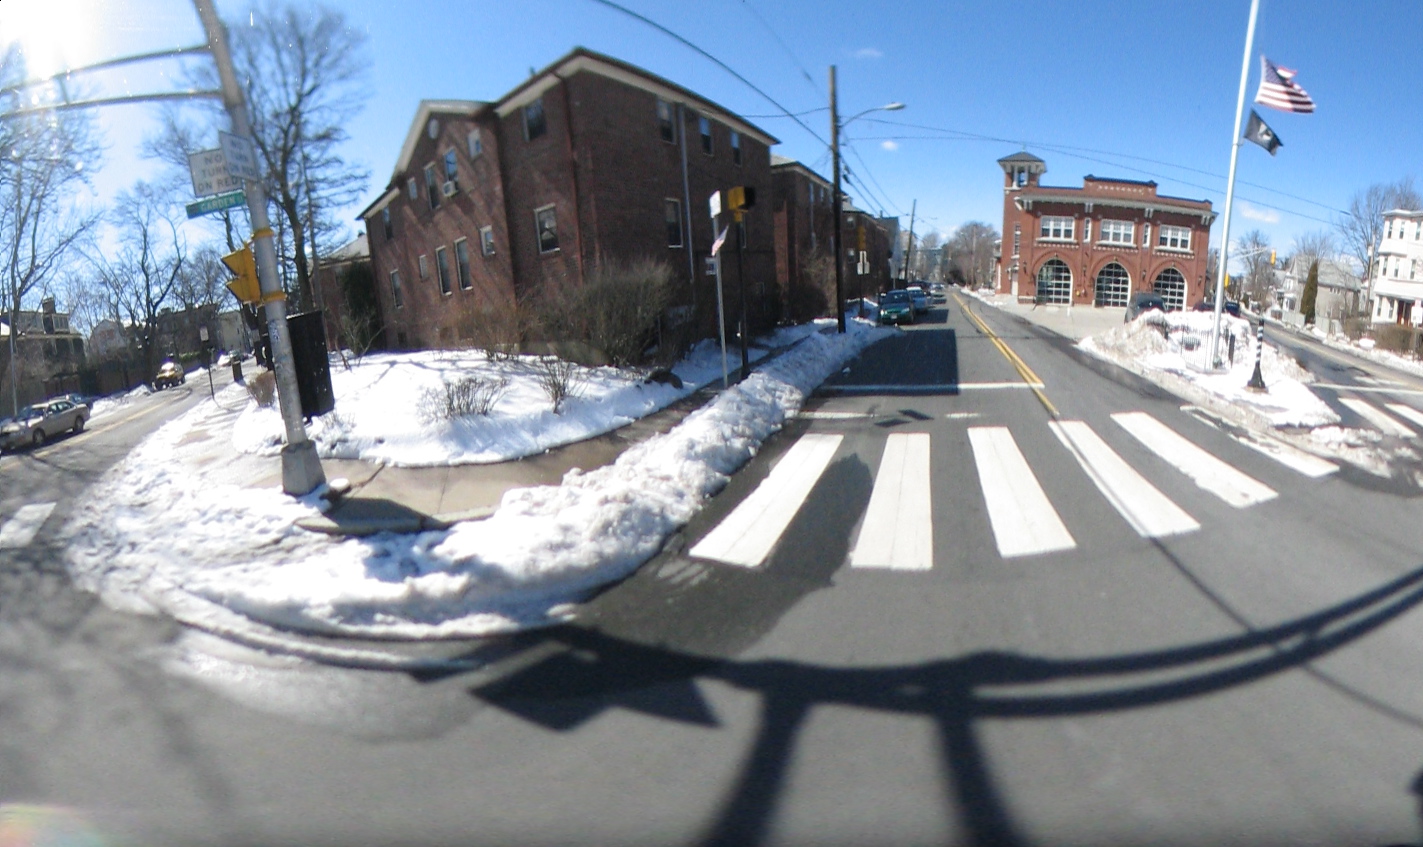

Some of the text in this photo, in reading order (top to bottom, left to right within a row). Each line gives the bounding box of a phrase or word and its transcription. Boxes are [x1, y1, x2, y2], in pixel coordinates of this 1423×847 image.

[204, 154, 222, 165] NO
[202, 165, 229, 178] TURN
[198, 176, 238, 192] ON RED
[201, 196, 236, 211] GARDEN
